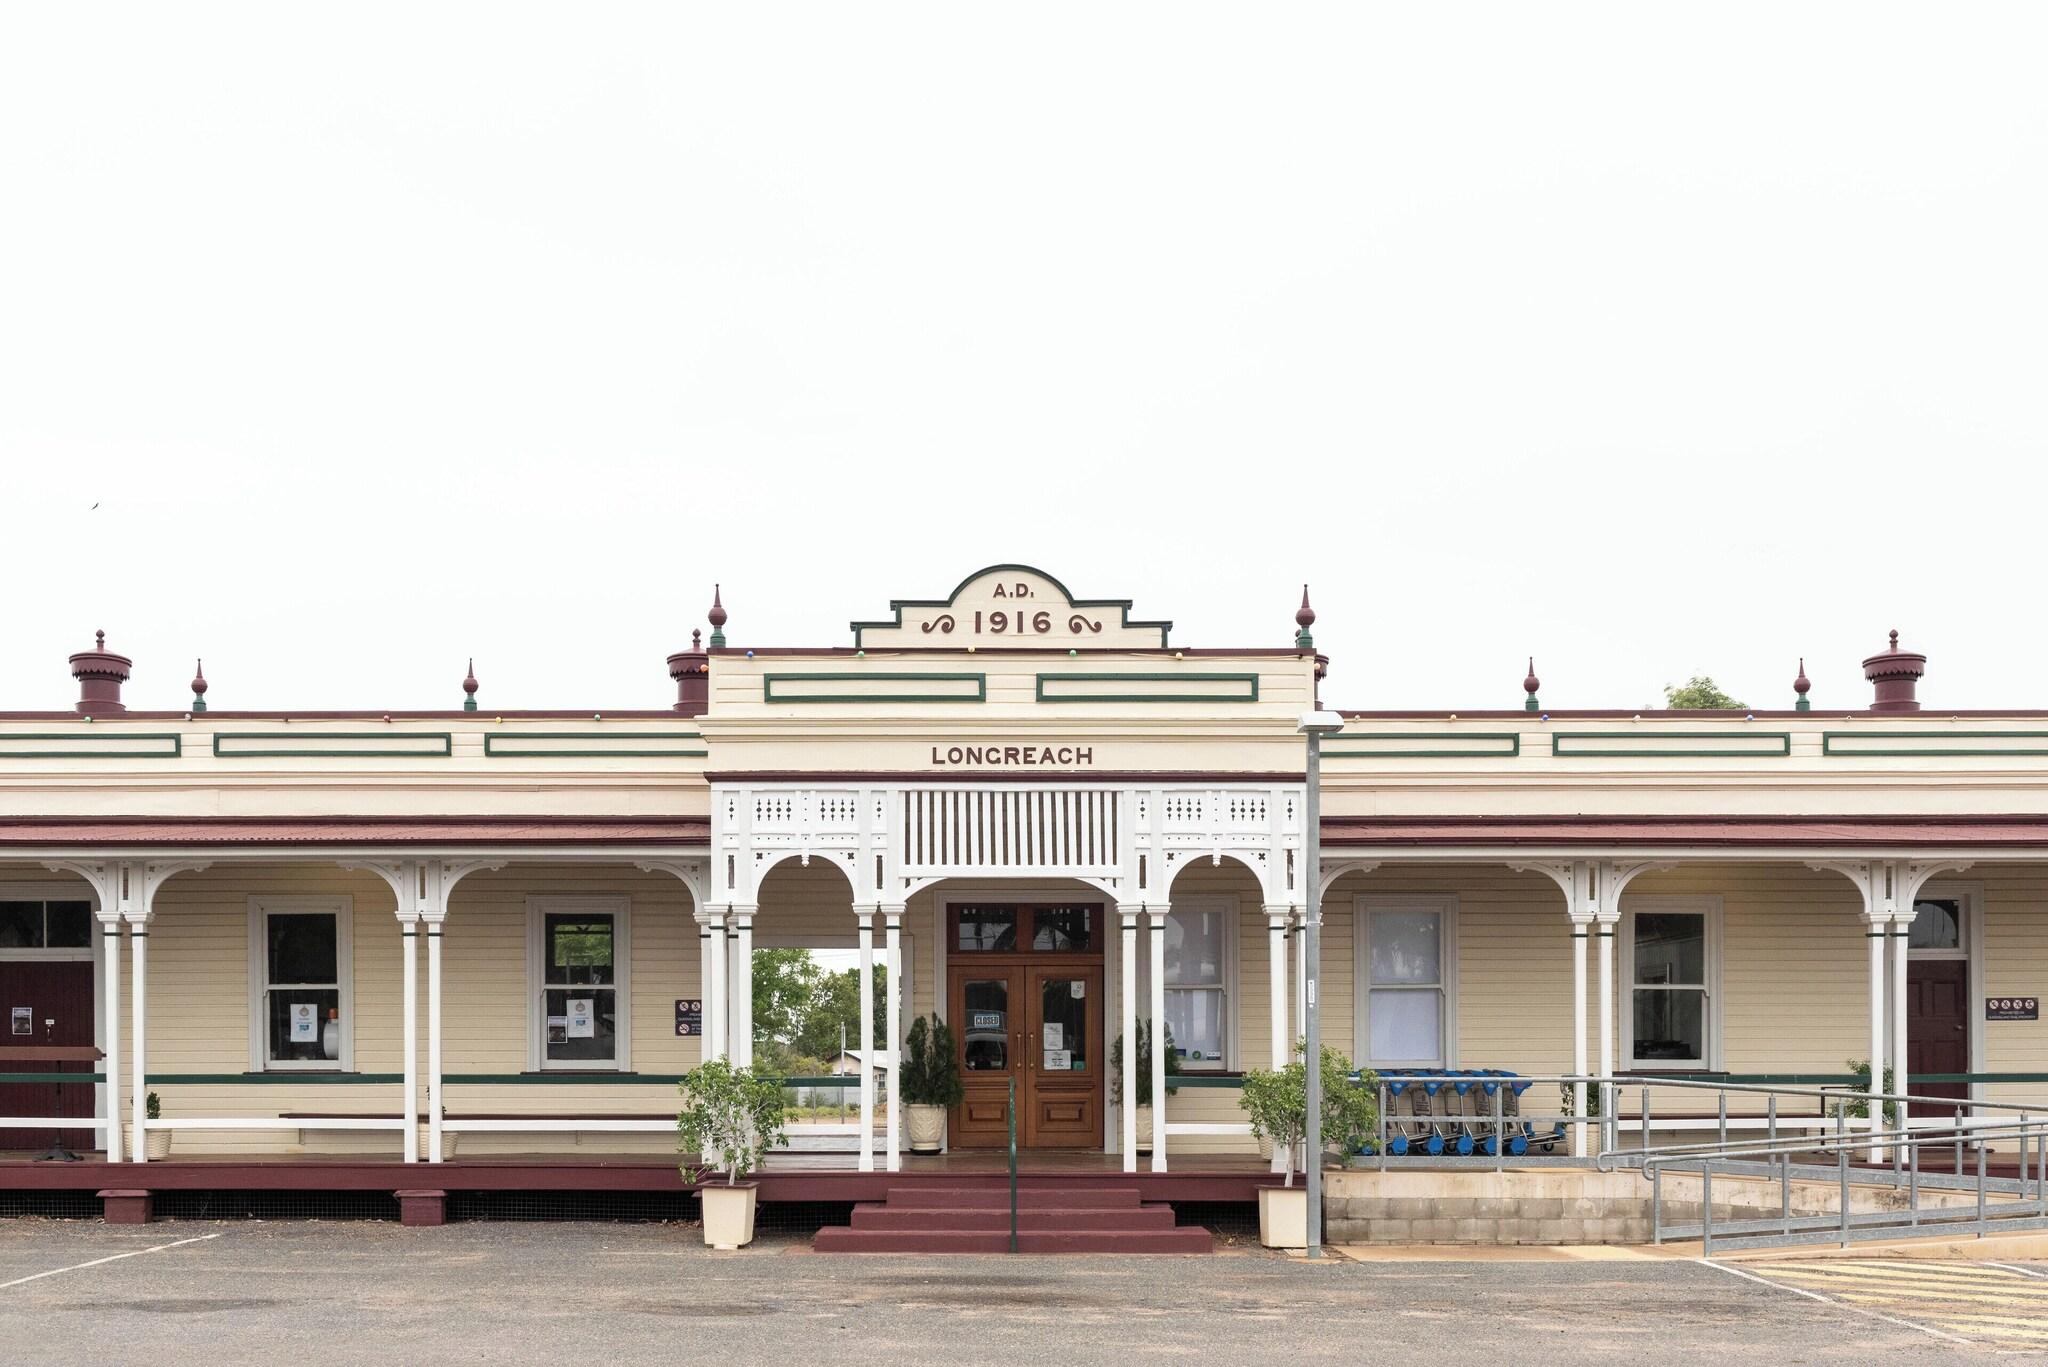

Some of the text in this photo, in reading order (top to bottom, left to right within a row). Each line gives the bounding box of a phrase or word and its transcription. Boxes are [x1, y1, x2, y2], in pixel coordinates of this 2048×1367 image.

[993, 583, 1034, 598] A.D.
[975, 611, 1051, 634] 1916
[932, 747, 1093, 765] LONGREACH
[976, 1016, 998, 1025] CLOSED
